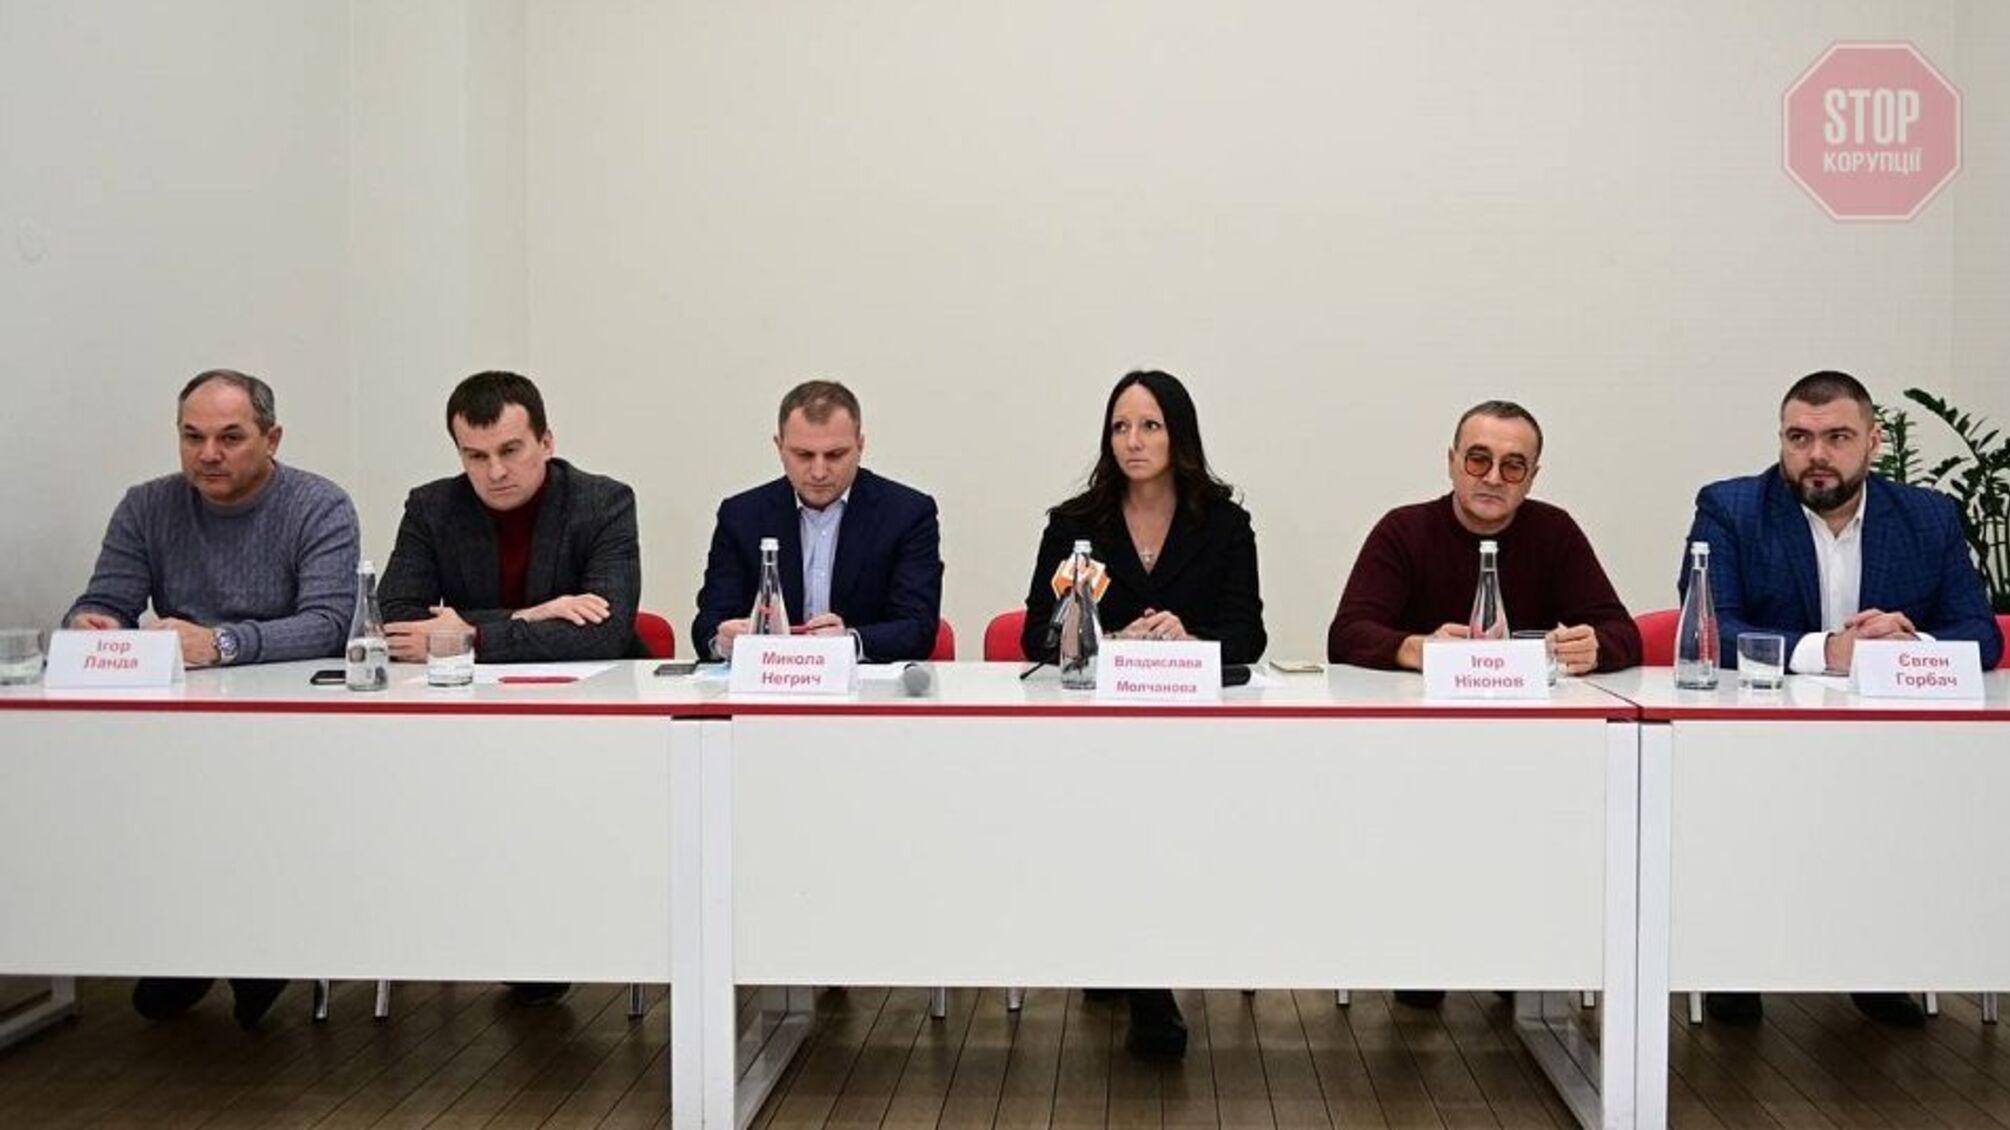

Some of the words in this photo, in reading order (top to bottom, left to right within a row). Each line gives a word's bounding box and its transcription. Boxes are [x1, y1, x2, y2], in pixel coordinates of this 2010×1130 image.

[96, 638, 131, 654] Ігор
[83, 655, 138, 670] Ланда
[762, 651, 825, 666] Микола
[1114, 655, 1202, 670] Владислава
[1471, 655, 1505, 670] Ігор
[1898, 652, 1949, 668] Євген
[762, 671, 822, 688] Негрич
[1116, 680, 1197, 693] Молчанова
[1454, 674, 1525, 689] Ніконов
[1896, 671, 1958, 688] Горбач
